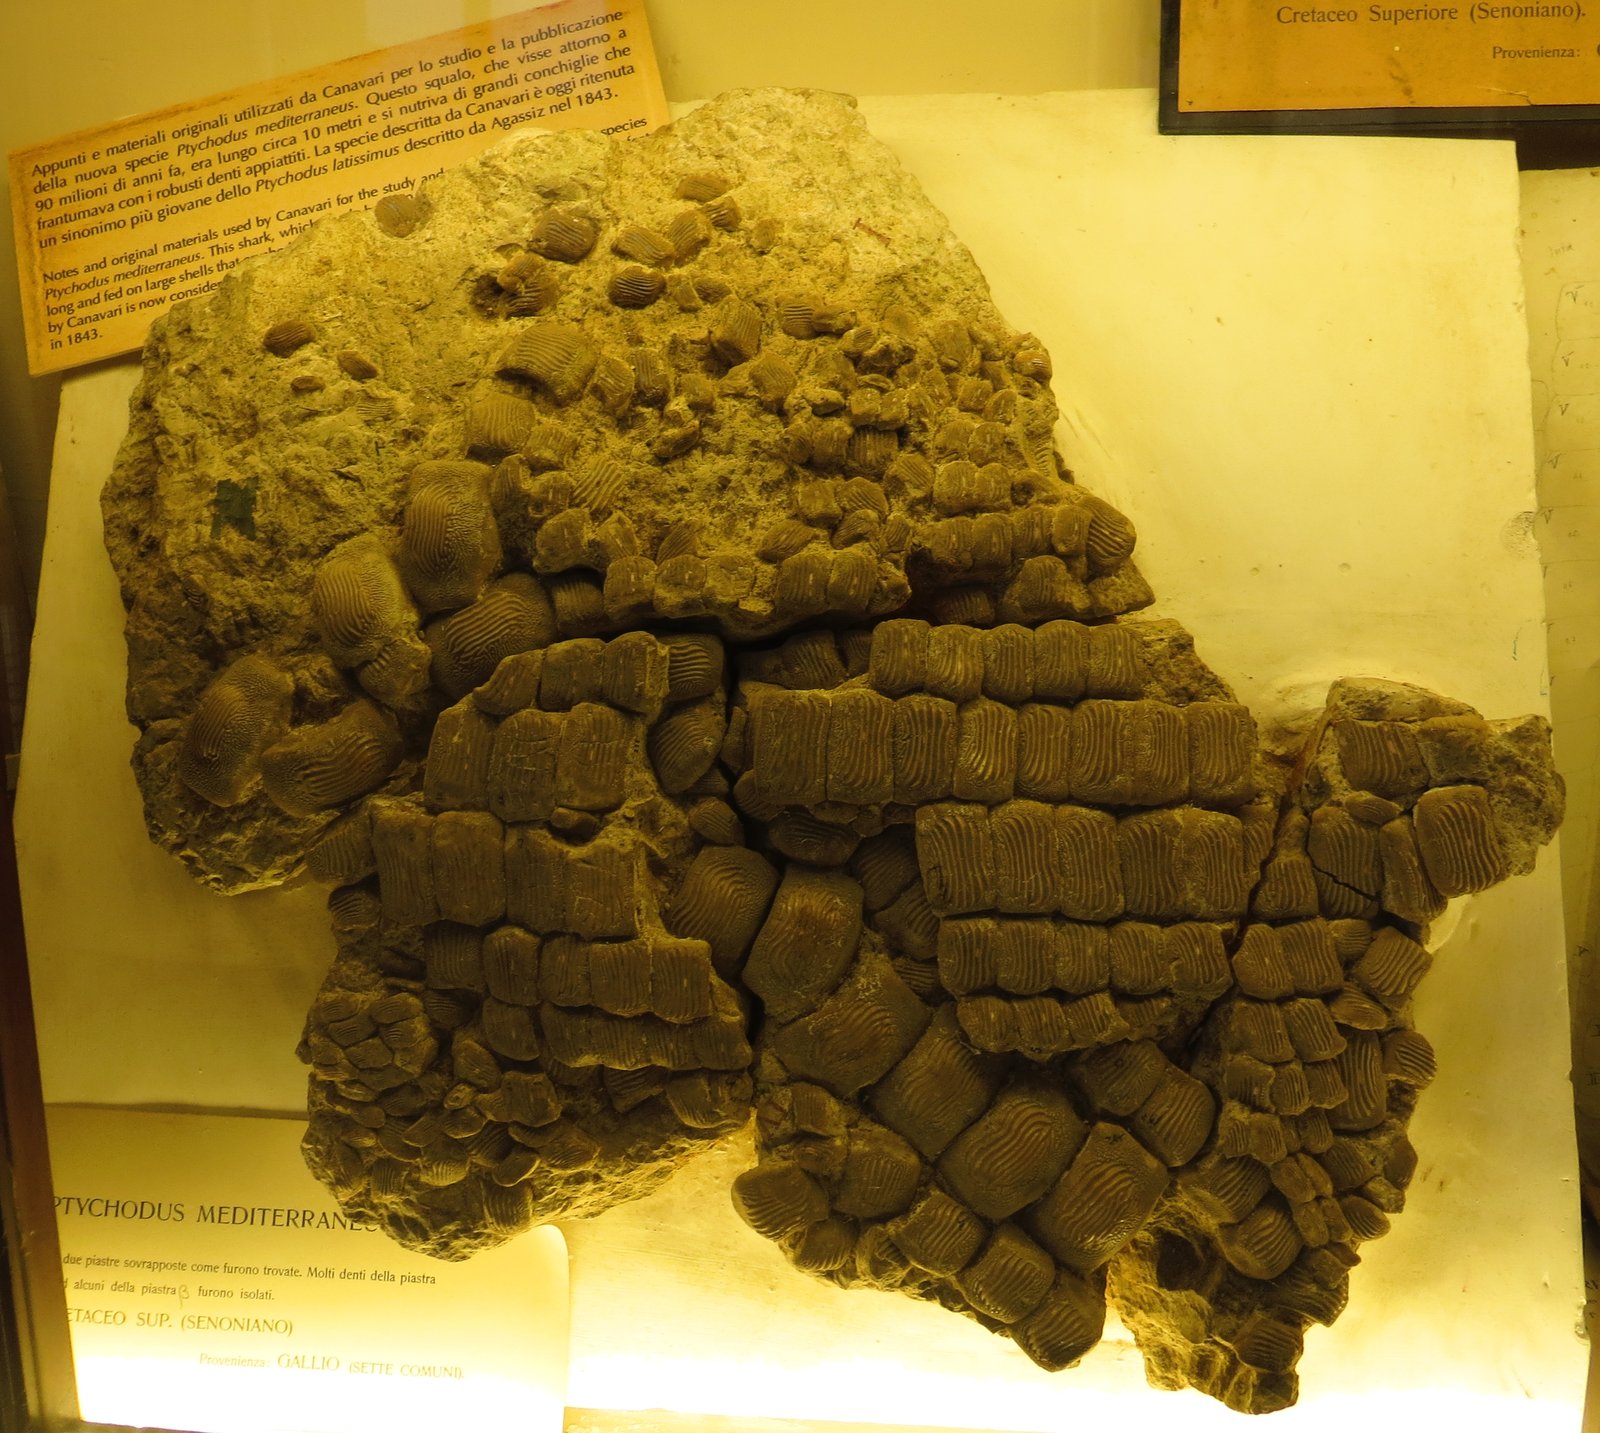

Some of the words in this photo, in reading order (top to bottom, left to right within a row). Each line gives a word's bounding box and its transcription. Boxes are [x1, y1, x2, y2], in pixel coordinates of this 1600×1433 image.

[1276, 6, 1358, 24] Cretaceo
[1369, 3, 1458, 24] Superiore
[1469, 1, 1586, 24] (Senoniano).
[1492, 46, 1580, 59] Provenienza:
[31, 151, 86, 177] Appunti
[91, 151, 100, 160] e
[105, 130, 166, 156] materiali
[171, 113, 228, 139] originali
[233, 95, 293, 122] utilizzati
[299, 90, 317, 104] da
[322, 71, 384, 98] Canavari
[390, 66, 413, 84] per
[418, 60, 433, 72] lo
[438, 47, 482, 67] studio
[486, 44, 496, 54] e
[501, 38, 515, 50] la
[520, 11, 623, 49] pubblicazione
[33, 176, 67, 194] della
[74, 164, 117, 183] nuova
[124, 150, 169, 172] specie
[177, 129, 248, 156] Ptychodus
[255, 100, 358, 135] mediterraneus.
[365, 84, 417, 106] Questo
[424, 68, 475, 90] squalo,
[483, 59, 509, 74] che
[516, 48, 552, 64] visse
[559, 33, 611, 54] attorno
[618, 28, 627, 39] a
[34, 197, 53, 212] 90
[58, 182, 107, 206] milioni
[112, 177, 126, 192] di
[132, 168, 162, 187] anni
[168, 164, 185, 177] fa,
[190, 158, 212, 171] era
[217, 146, 257, 164] lungo
[262, 135, 297, 152] circa
[302, 126, 321, 141] 10
[326, 114, 362, 135] metri
[367, 113, 377, 123] e
[381, 106, 393, 120] si
[399, 95, 448, 115] nutriva
[452, 86, 467, 101] di
[472, 73, 518, 99] grandi
[524, 54, 599, 82] conchiglie
[604, 46, 631, 61] che
[36, 202, 115, 230] frantumava
[118, 194, 144, 209] con
[147, 189, 152, 202] i
[155, 176, 203, 199] robusti
[206, 165, 241, 186] denti
[245, 148, 310, 177] appiattiti.
[314, 144, 331, 157] La
[333, 130, 379, 154] specie
[381, 115, 442, 138] descritta
[444, 107, 462, 122] da
[465, 88, 530, 116] Canavari
[533, 86, 543, 99] è
[545, 76, 576, 97] oggi
[579, 64, 635, 86] ritenuta
[38, 236, 57, 249] un
[60, 219, 126, 243] sinonimo
[130, 209, 153, 229] più
[156, 196, 212, 222] giovane
[215, 183, 252, 202] dello
[255, 164, 328, 192] Ptychodus
[332, 145, 399, 171] latissimus
[403, 128, 464, 152] descritto
[468, 120, 486, 135] da
[491, 106, 546, 130] Agassiz
[549, 96, 572, 114] nel
[575, 87, 618, 106] 1843.
[42, 267, 79, 283] Notes
[83, 256, 107, 273] and
[110, 243, 158, 266] original
[162, 228, 219, 253] materials
[222, 218, 252, 236] used
[255, 215, 271, 228] by
[275, 197, 332, 221] Canavari
[336, 193, 353, 206] for
[357, 187, 378, 200] the
[382, 176, 416, 194] study
[599, 118, 647, 137] species
[43, 275, 109, 300] Ptychodus
[113, 252, 205, 283] mediterraneus.
[207, 242, 235, 256] This
[237, 230, 275, 249] shark,
[46, 302, 75, 316] long
[76, 291, 101, 309] and
[103, 285, 123, 302] fed
[125, 285, 142, 296] on
[144, 276, 176, 291] large
[178, 263, 214, 282] shells
[47, 321, 64, 334] by
[66, 303, 122, 328] Canavari
[125, 302, 136, 313] is
[138, 295, 166, 310] now
[50, 338, 62, 350] in
[67, 328, 103, 345] 1843.
[63, 1252, 82, 1265] due
[84, 1254, 120, 1268] piastre
[123, 1258, 187, 1272] sovrapposte
[190, 1263, 220, 1273] come
[222, 1262, 259, 1277] furono
[263, 1265, 302, 1279] trovate.
[306, 1266, 335, 1279] Molti
[338, 1267, 366, 1280] denti
[369, 1269, 396, 1282] della
[399, 1271, 436, 1286] piastra
[73, 1278, 104, 1290] alcuni
[110, 1280, 135, 1292] della
[141, 1284, 176, 1296] piastra
[197, 1285, 234, 1299] furono
[239, 1288, 275, 1300] isolati.
[135, 1311, 172, 1327] SUP.
[180, 1314, 293, 1337] (SENONIANO)
